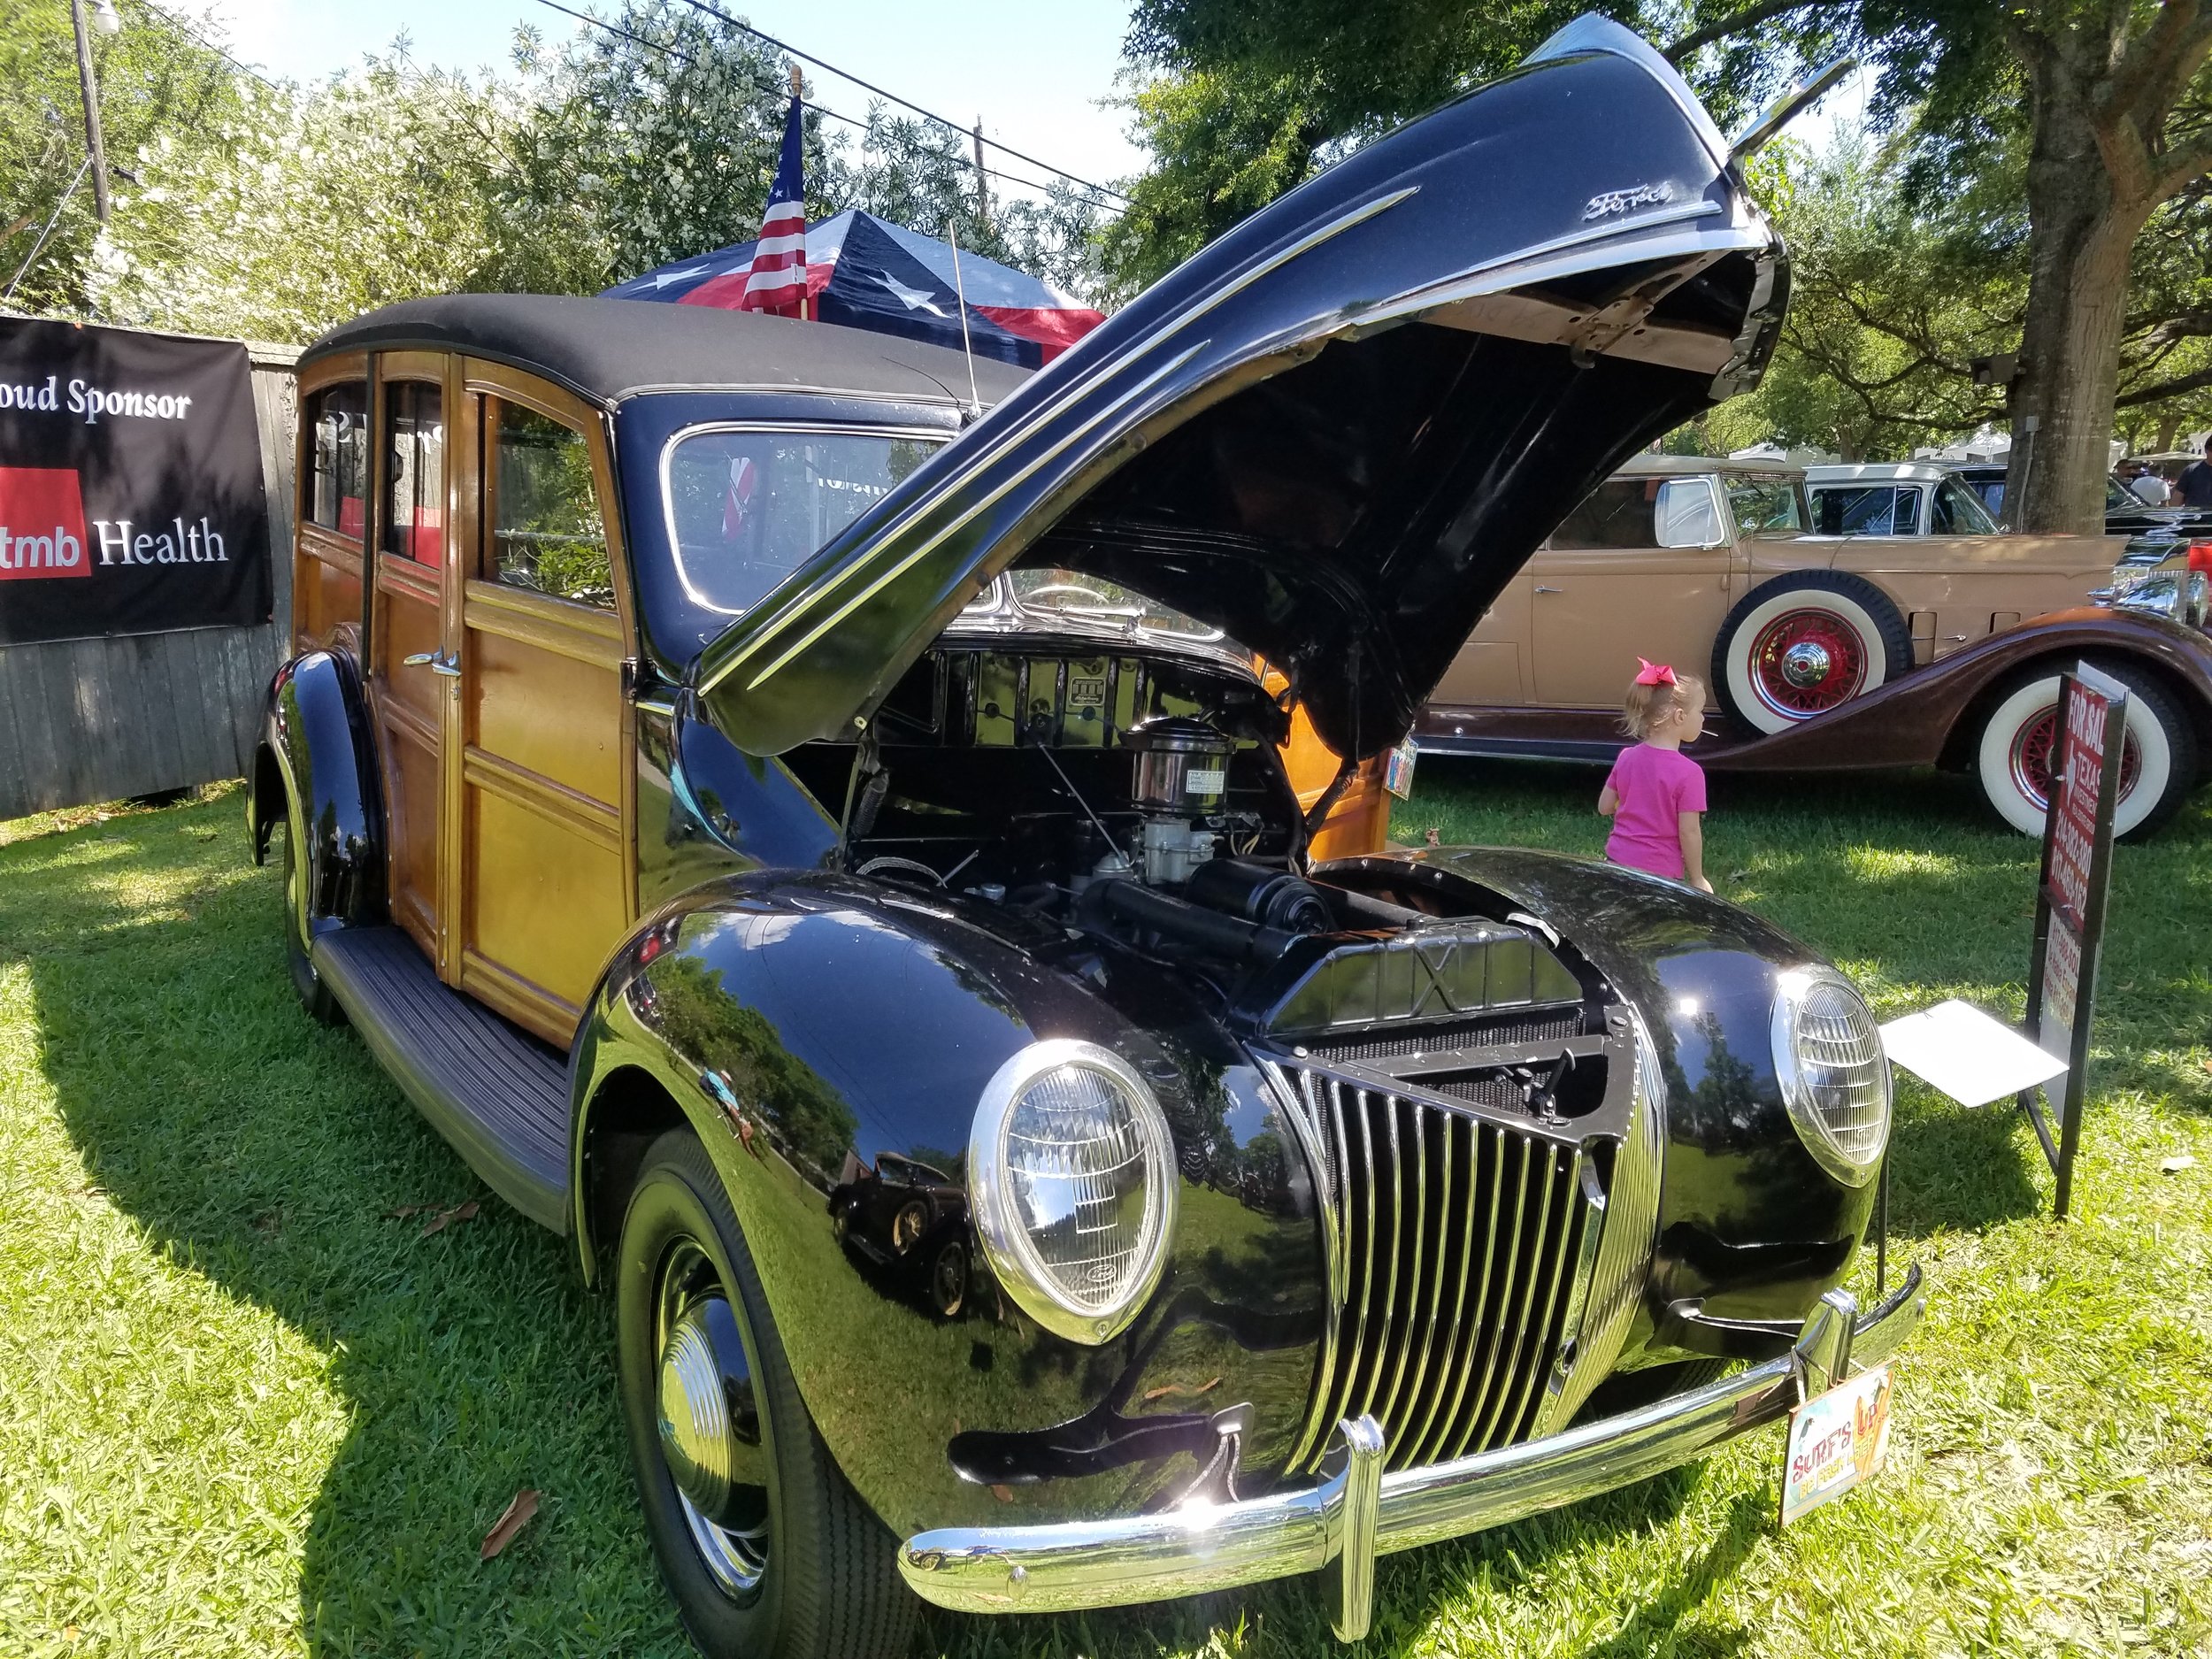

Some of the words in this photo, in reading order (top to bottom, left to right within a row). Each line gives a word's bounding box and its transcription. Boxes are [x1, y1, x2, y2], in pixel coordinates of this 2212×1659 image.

[1581, 181, 1672, 221] Ford
[67, 379, 192, 425] Sponsor
[92, 517, 229, 566] Health
[2068, 690, 2087, 741] FOR
[1857, 1403, 1878, 1436] UP
